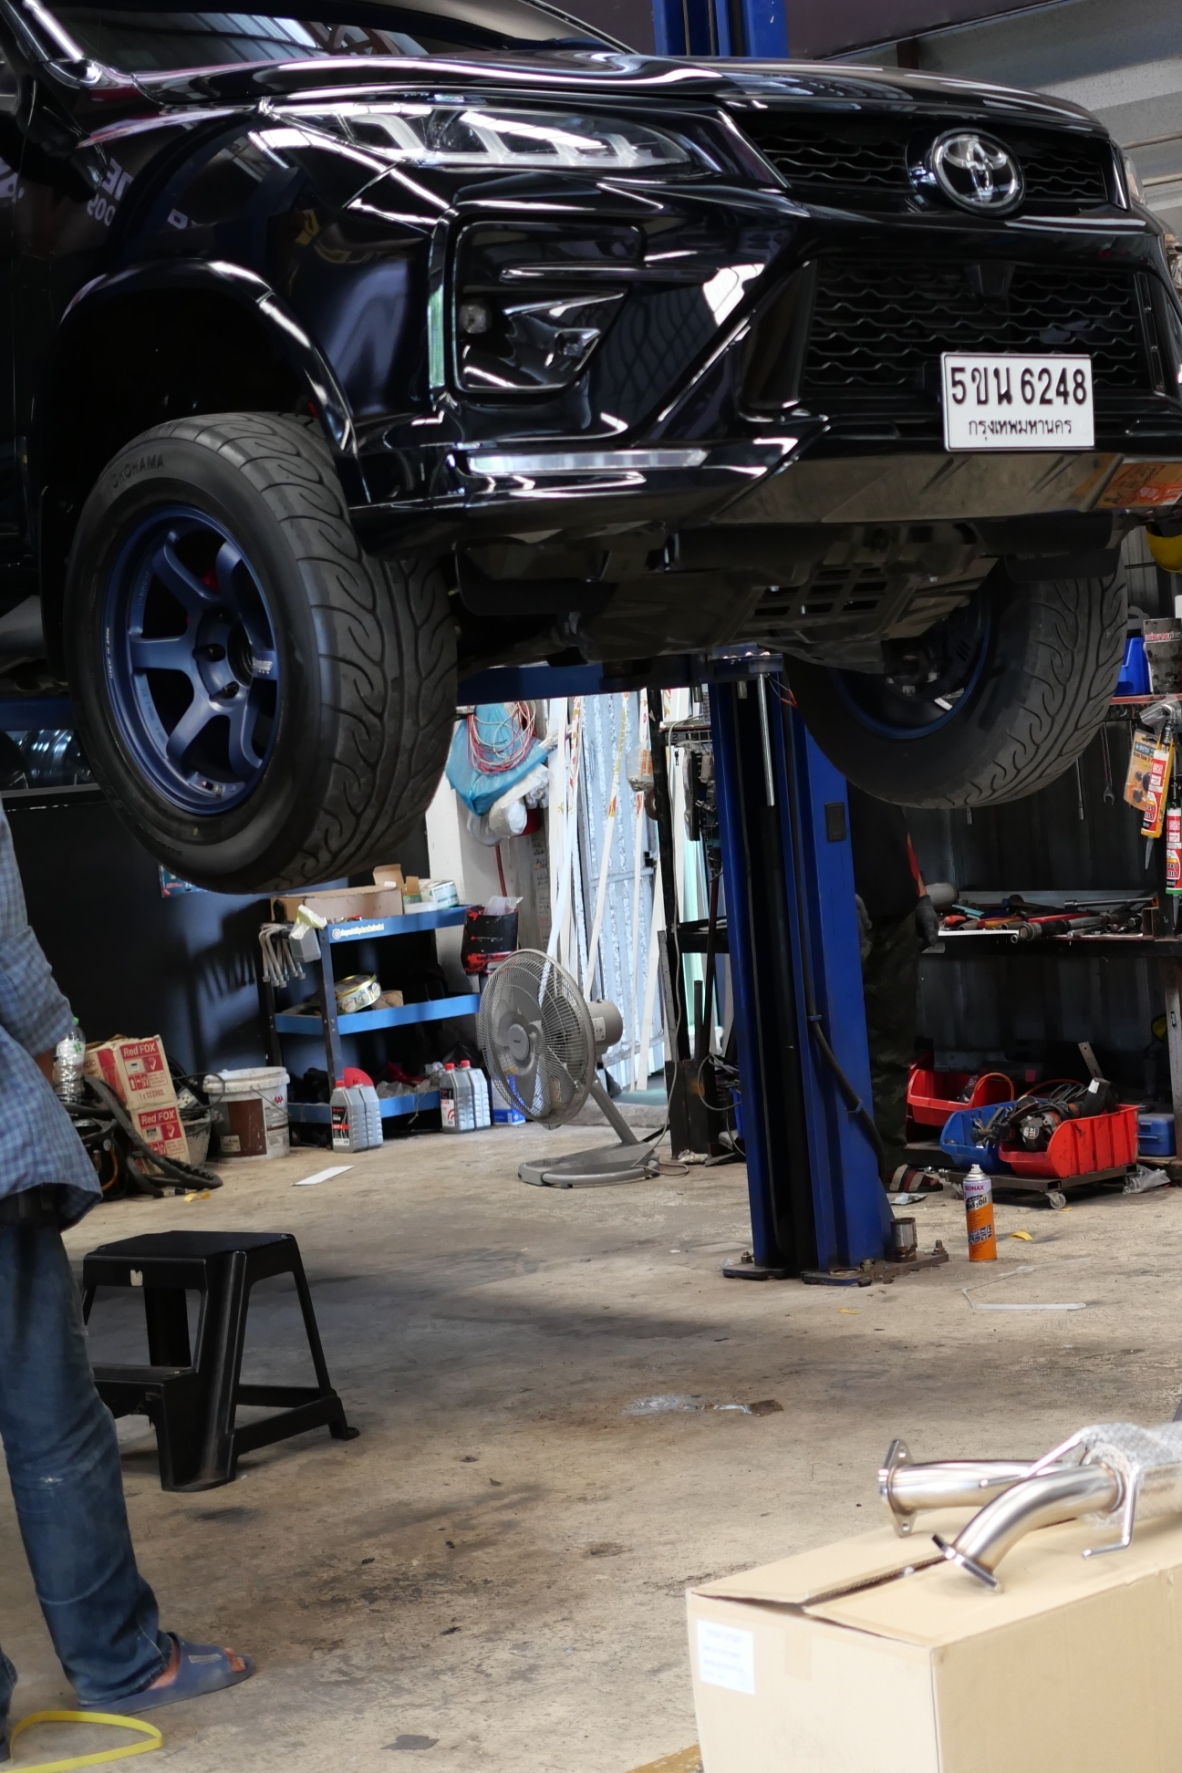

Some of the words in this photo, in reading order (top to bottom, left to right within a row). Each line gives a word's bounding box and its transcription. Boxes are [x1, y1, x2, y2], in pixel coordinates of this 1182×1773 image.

[1020, 367, 1087, 405] 6248
[968, 419, 1072, 441] กรุงเทพมหานคร
[106, 454, 165, 492] OKOHAMA
[123, 1047, 138, 1057] Red
[140, 1042, 156, 1054] FOX
[141, 1115, 157, 1126] Red
[157, 1110, 175, 1121] FOX
